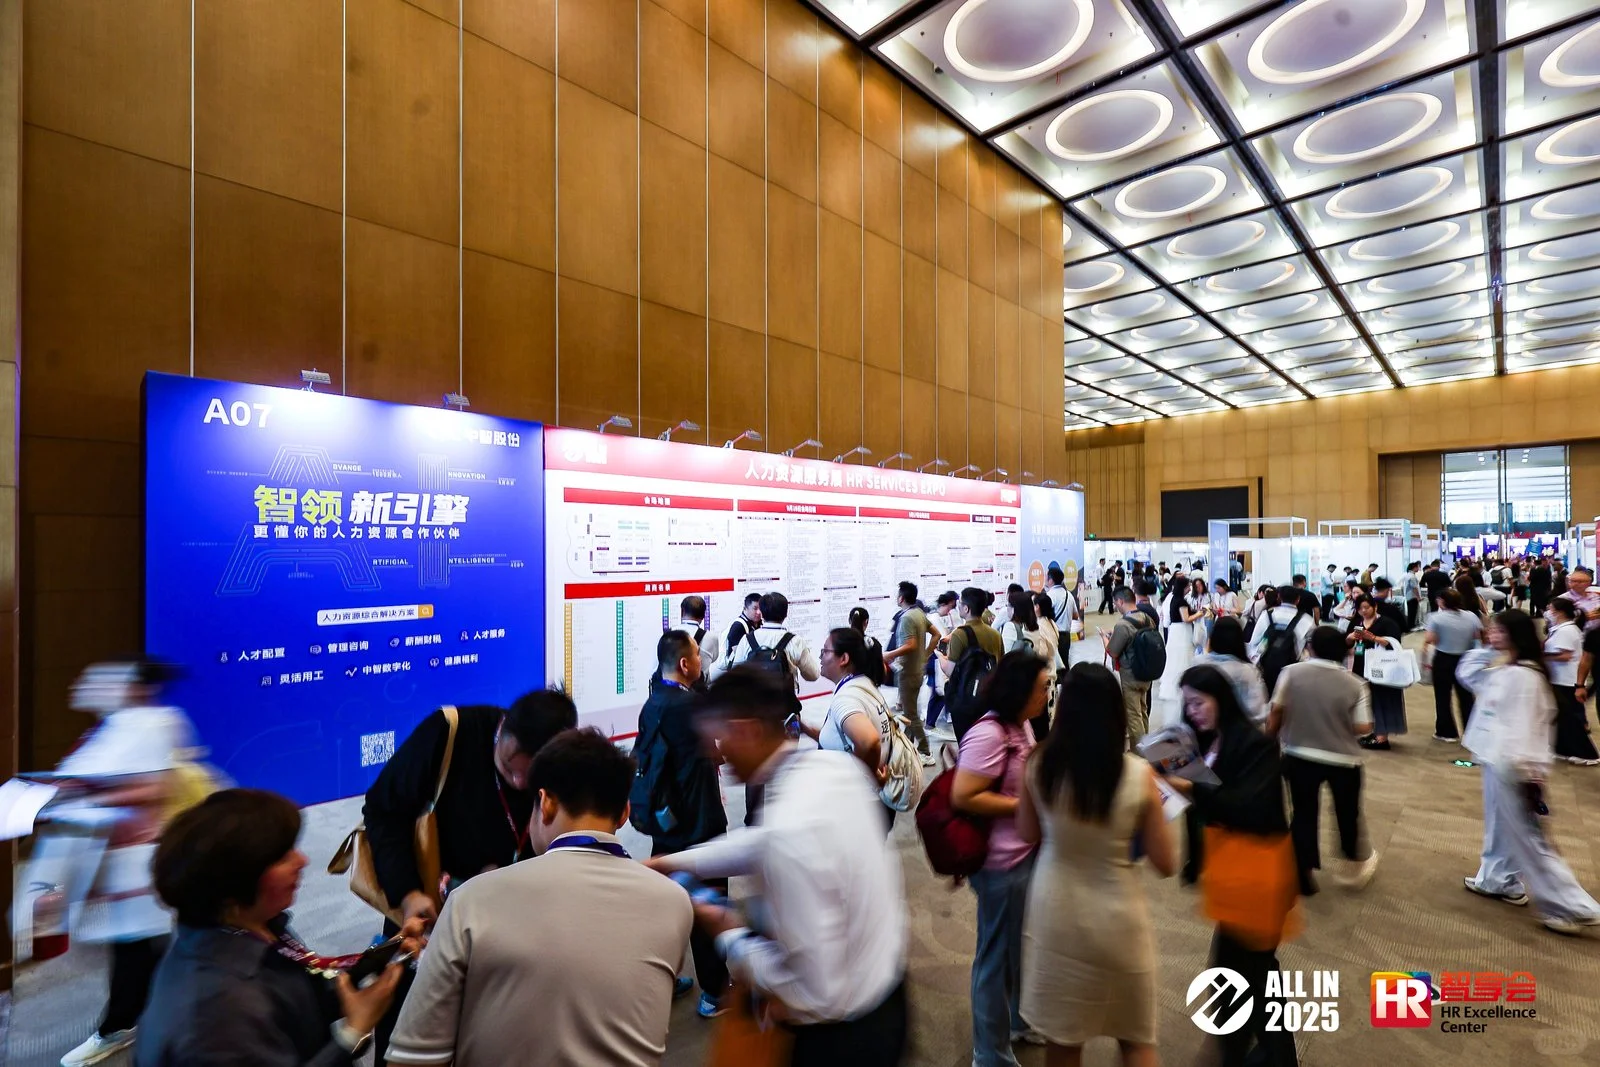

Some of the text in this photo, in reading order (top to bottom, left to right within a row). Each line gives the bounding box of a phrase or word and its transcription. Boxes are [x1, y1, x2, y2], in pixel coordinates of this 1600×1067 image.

[203, 398, 273, 428] A07
[846, 471, 864, 488] HR
[866, 475, 919, 494] SERVICES
[920, 480, 946, 497] EXPO
[254, 485, 470, 526] 智领 新引擎
[253, 524, 460, 540] 更懂你的人力资源合作伙伴
[322, 608, 415, 622] 人力资源综合解决方案
[404, 634, 442, 647] 薪酬财税
[473, 628, 506, 641] 人才服务
[238, 647, 286, 662] 人才配置
[327, 640, 369, 654] 管理咨询
[444, 653, 479, 667] 健康福利
[362, 661, 411, 676] 中智数字化
[280, 670, 324, 685] 灵活用工
